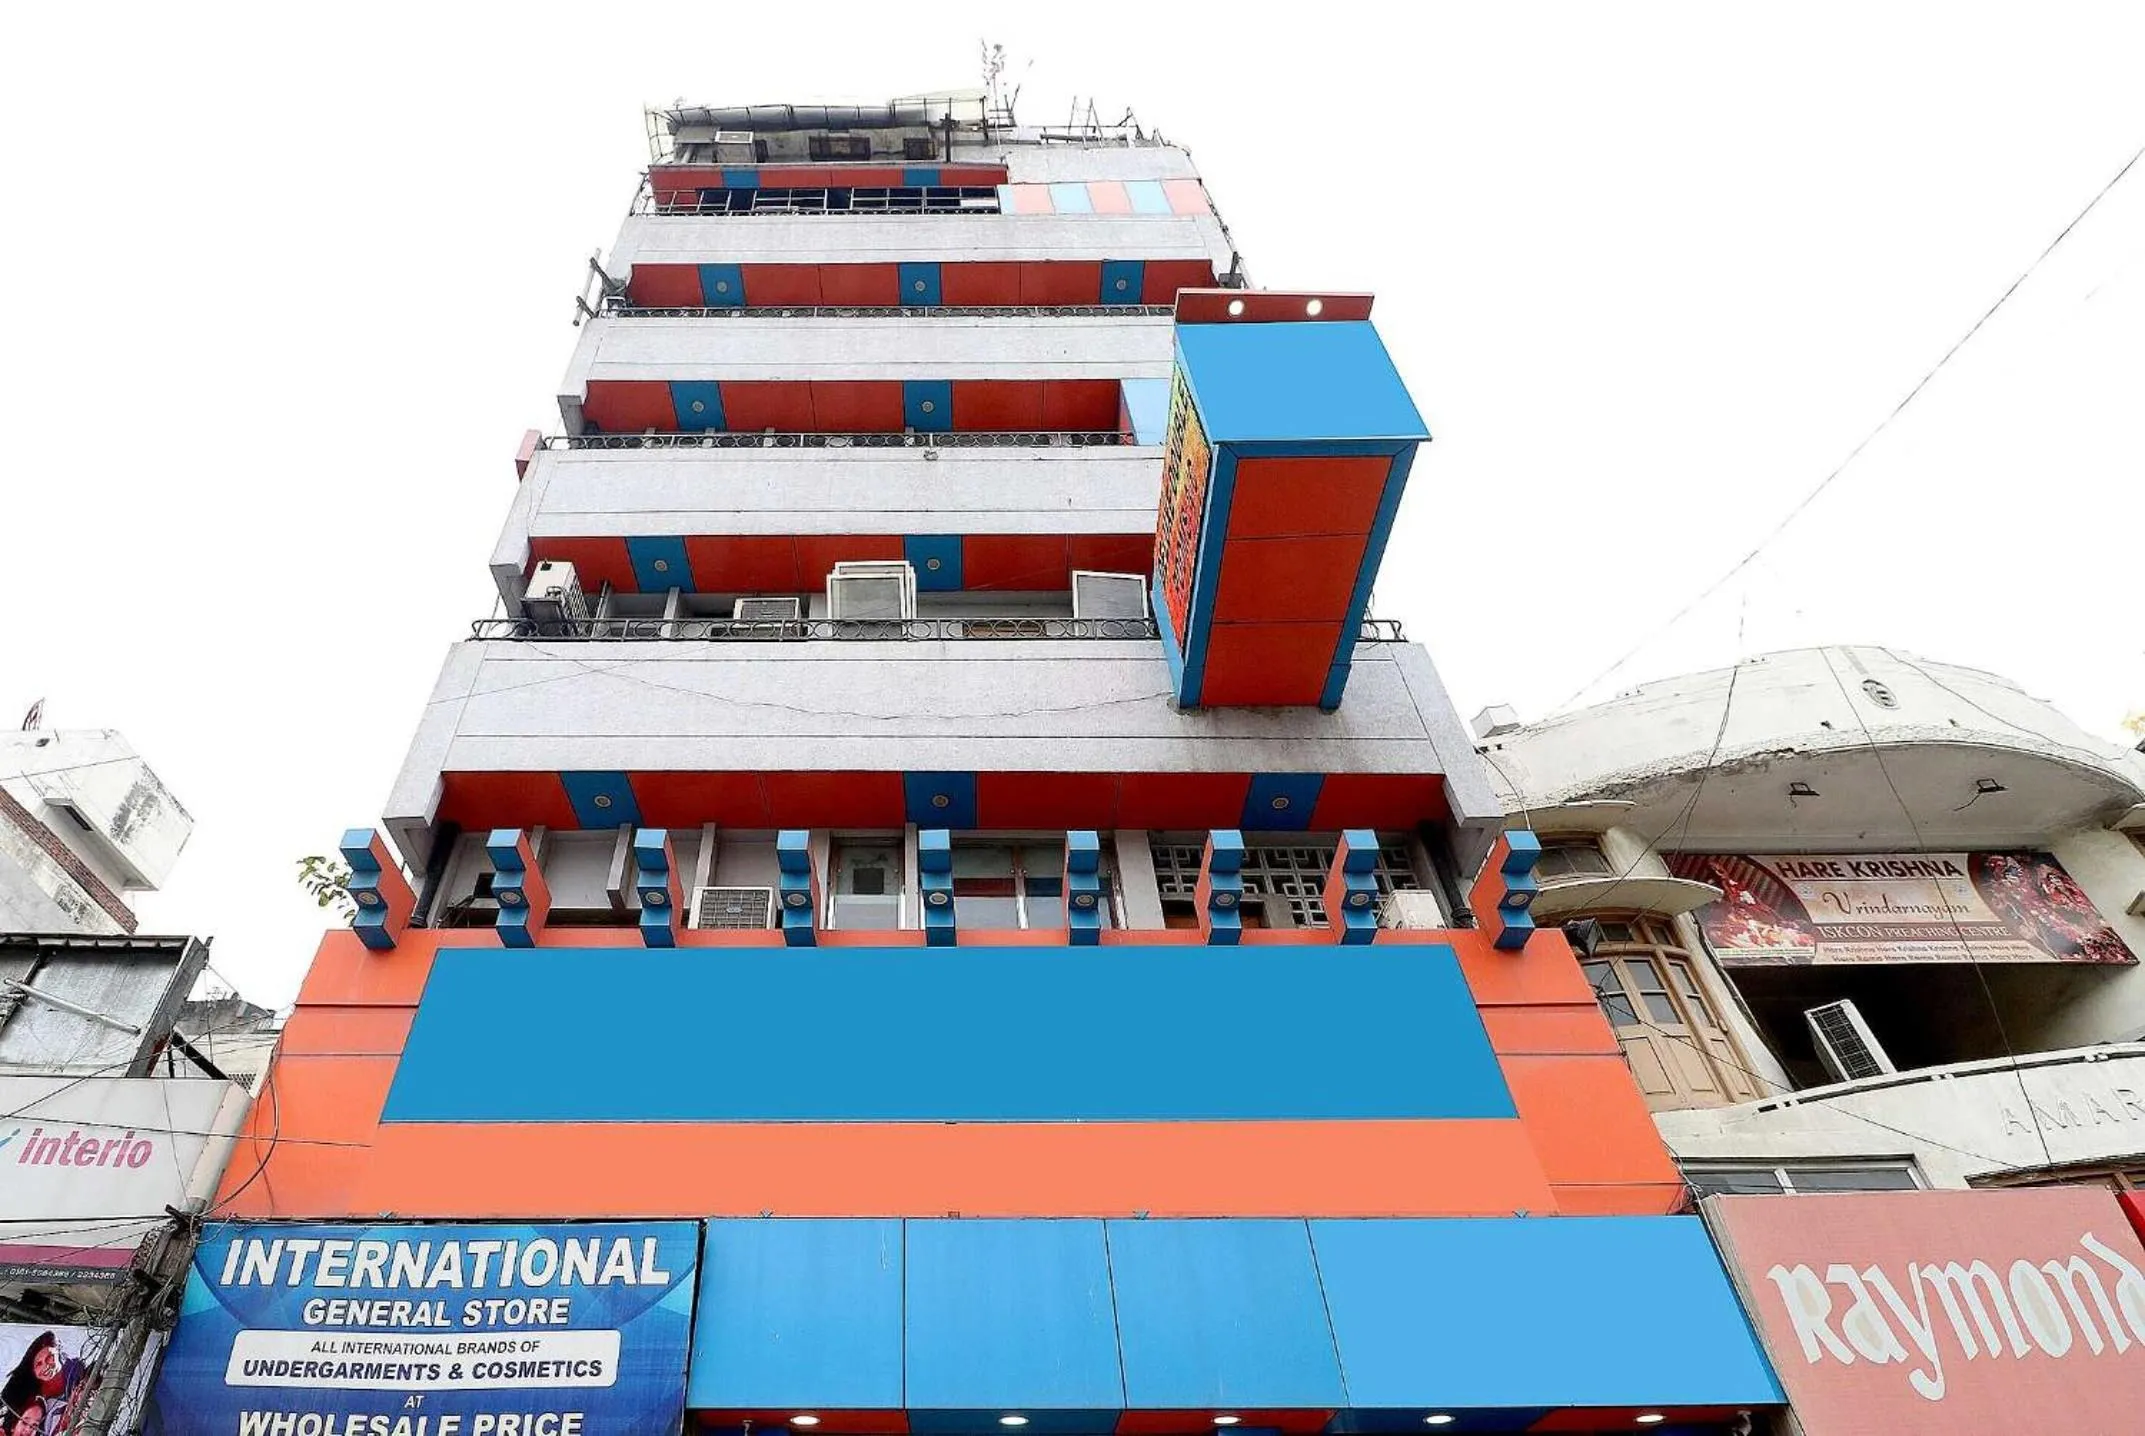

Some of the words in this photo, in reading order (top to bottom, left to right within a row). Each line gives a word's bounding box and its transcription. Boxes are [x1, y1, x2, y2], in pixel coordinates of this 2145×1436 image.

[1167, 376, 1188, 496] DOUBLE
[1775, 861, 1846, 878] HARE
[1849, 860, 1964, 877] KRISHNA
[1817, 926, 1883, 939] ISKCON
[1884, 927, 1961, 937] PREACHING
[1961, 926, 2012, 936] CENTRE
[18, 1127, 153, 1168] interio
[219, 1236, 671, 1289] INTERNATIONAL
[303, 1298, 451, 1327] GENERAL
[462, 1298, 571, 1326] STORE
[310, 1341, 339, 1353] ALL
[341, 1343, 450, 1355] INTERNATIONAL
[457, 1341, 516, 1354] BRANDS
[520, 1340, 541, 1353] OF
[243, 1360, 441, 1381] UNDERGARMENTS
[449, 1363, 464, 1380] &
[472, 1360, 602, 1379] COSMETICS
[404, 1395, 425, 1409] AT
[473, 1412, 584, 1436] PRICE
